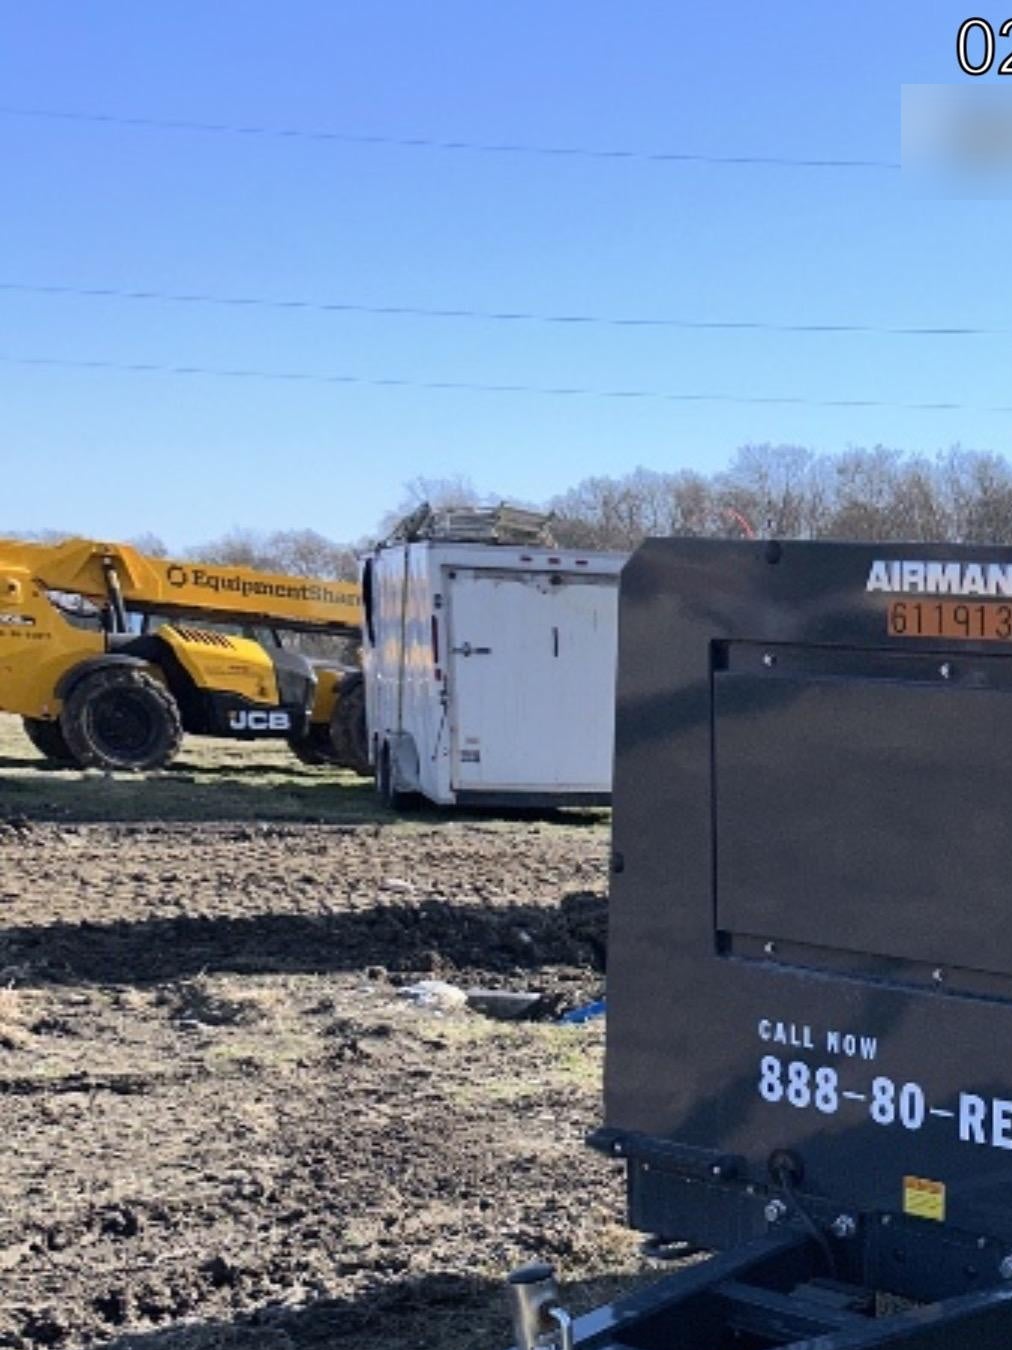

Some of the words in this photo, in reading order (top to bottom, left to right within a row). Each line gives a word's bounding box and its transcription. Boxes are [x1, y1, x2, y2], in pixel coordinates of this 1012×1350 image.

[191, 569, 362, 607] EquipmentShar
[891, 602, 1012, 640] 611913
[228, 710, 290, 731] JCB
[758, 1018, 815, 1049] CALL
[826, 1030, 879, 1060] NOW
